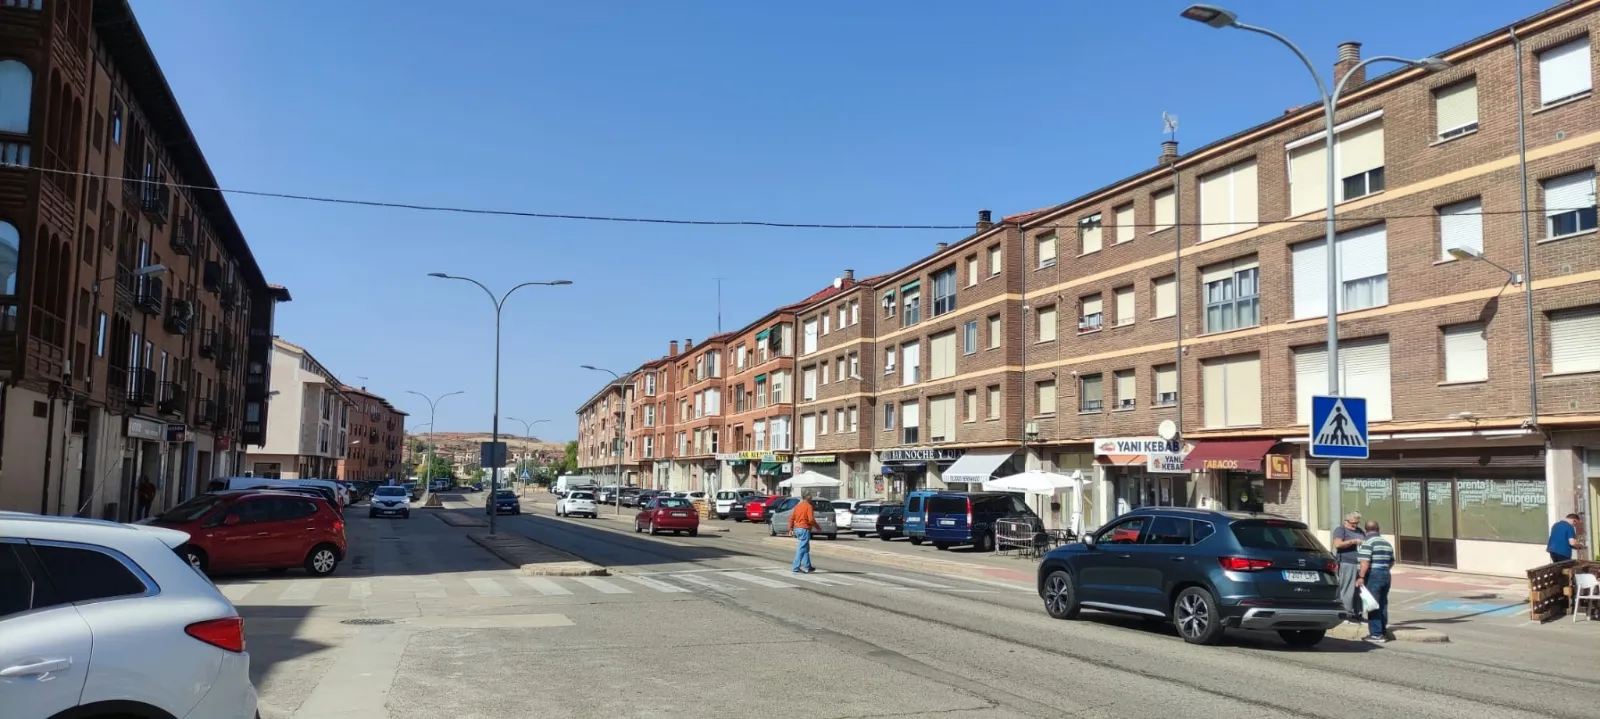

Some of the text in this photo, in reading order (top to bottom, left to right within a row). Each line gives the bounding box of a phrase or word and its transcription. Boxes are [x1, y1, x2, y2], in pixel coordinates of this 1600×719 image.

[1117, 440, 1180, 452] YANI KEBAB
[892, 450, 903, 460] BAR
[905, 450, 934, 459] NOCHE
[938, 450, 945, 459] Y
[1203, 460, 1239, 469] TABACOS
[1353, 478, 1386, 489] Imprenta
[1502, 493, 1546, 505] Imprenta
